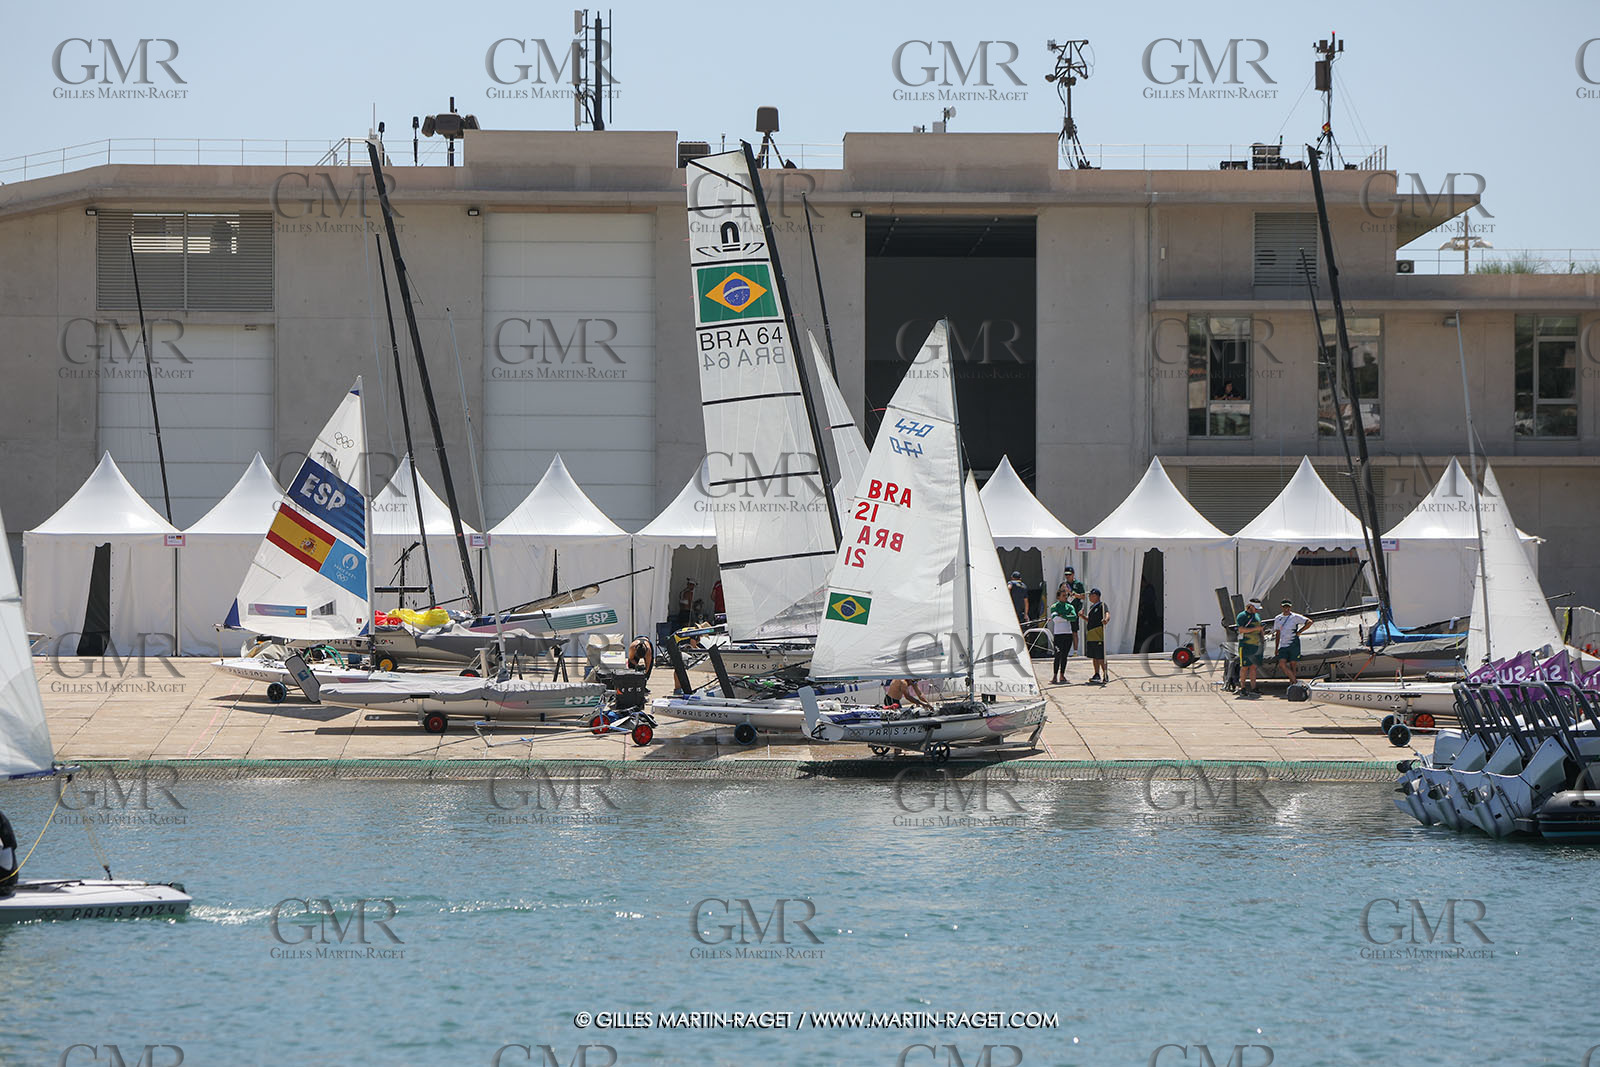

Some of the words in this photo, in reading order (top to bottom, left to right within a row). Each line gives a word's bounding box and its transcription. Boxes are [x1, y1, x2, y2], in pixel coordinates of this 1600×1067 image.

[700, 328, 752, 351] BRA
[757, 326, 783, 345] 64
[895, 418, 935, 438] 470
[300, 473, 346, 511] ESP
[868, 479, 912, 508] BRA
[855, 501, 879, 522] 21
[585, 612, 609, 624] ESP
[677, 709, 702, 717] PARIS
[869, 727, 899, 736] PARIS
[72, 906, 122, 919] PARIS
[130, 904, 176, 917] 2024
